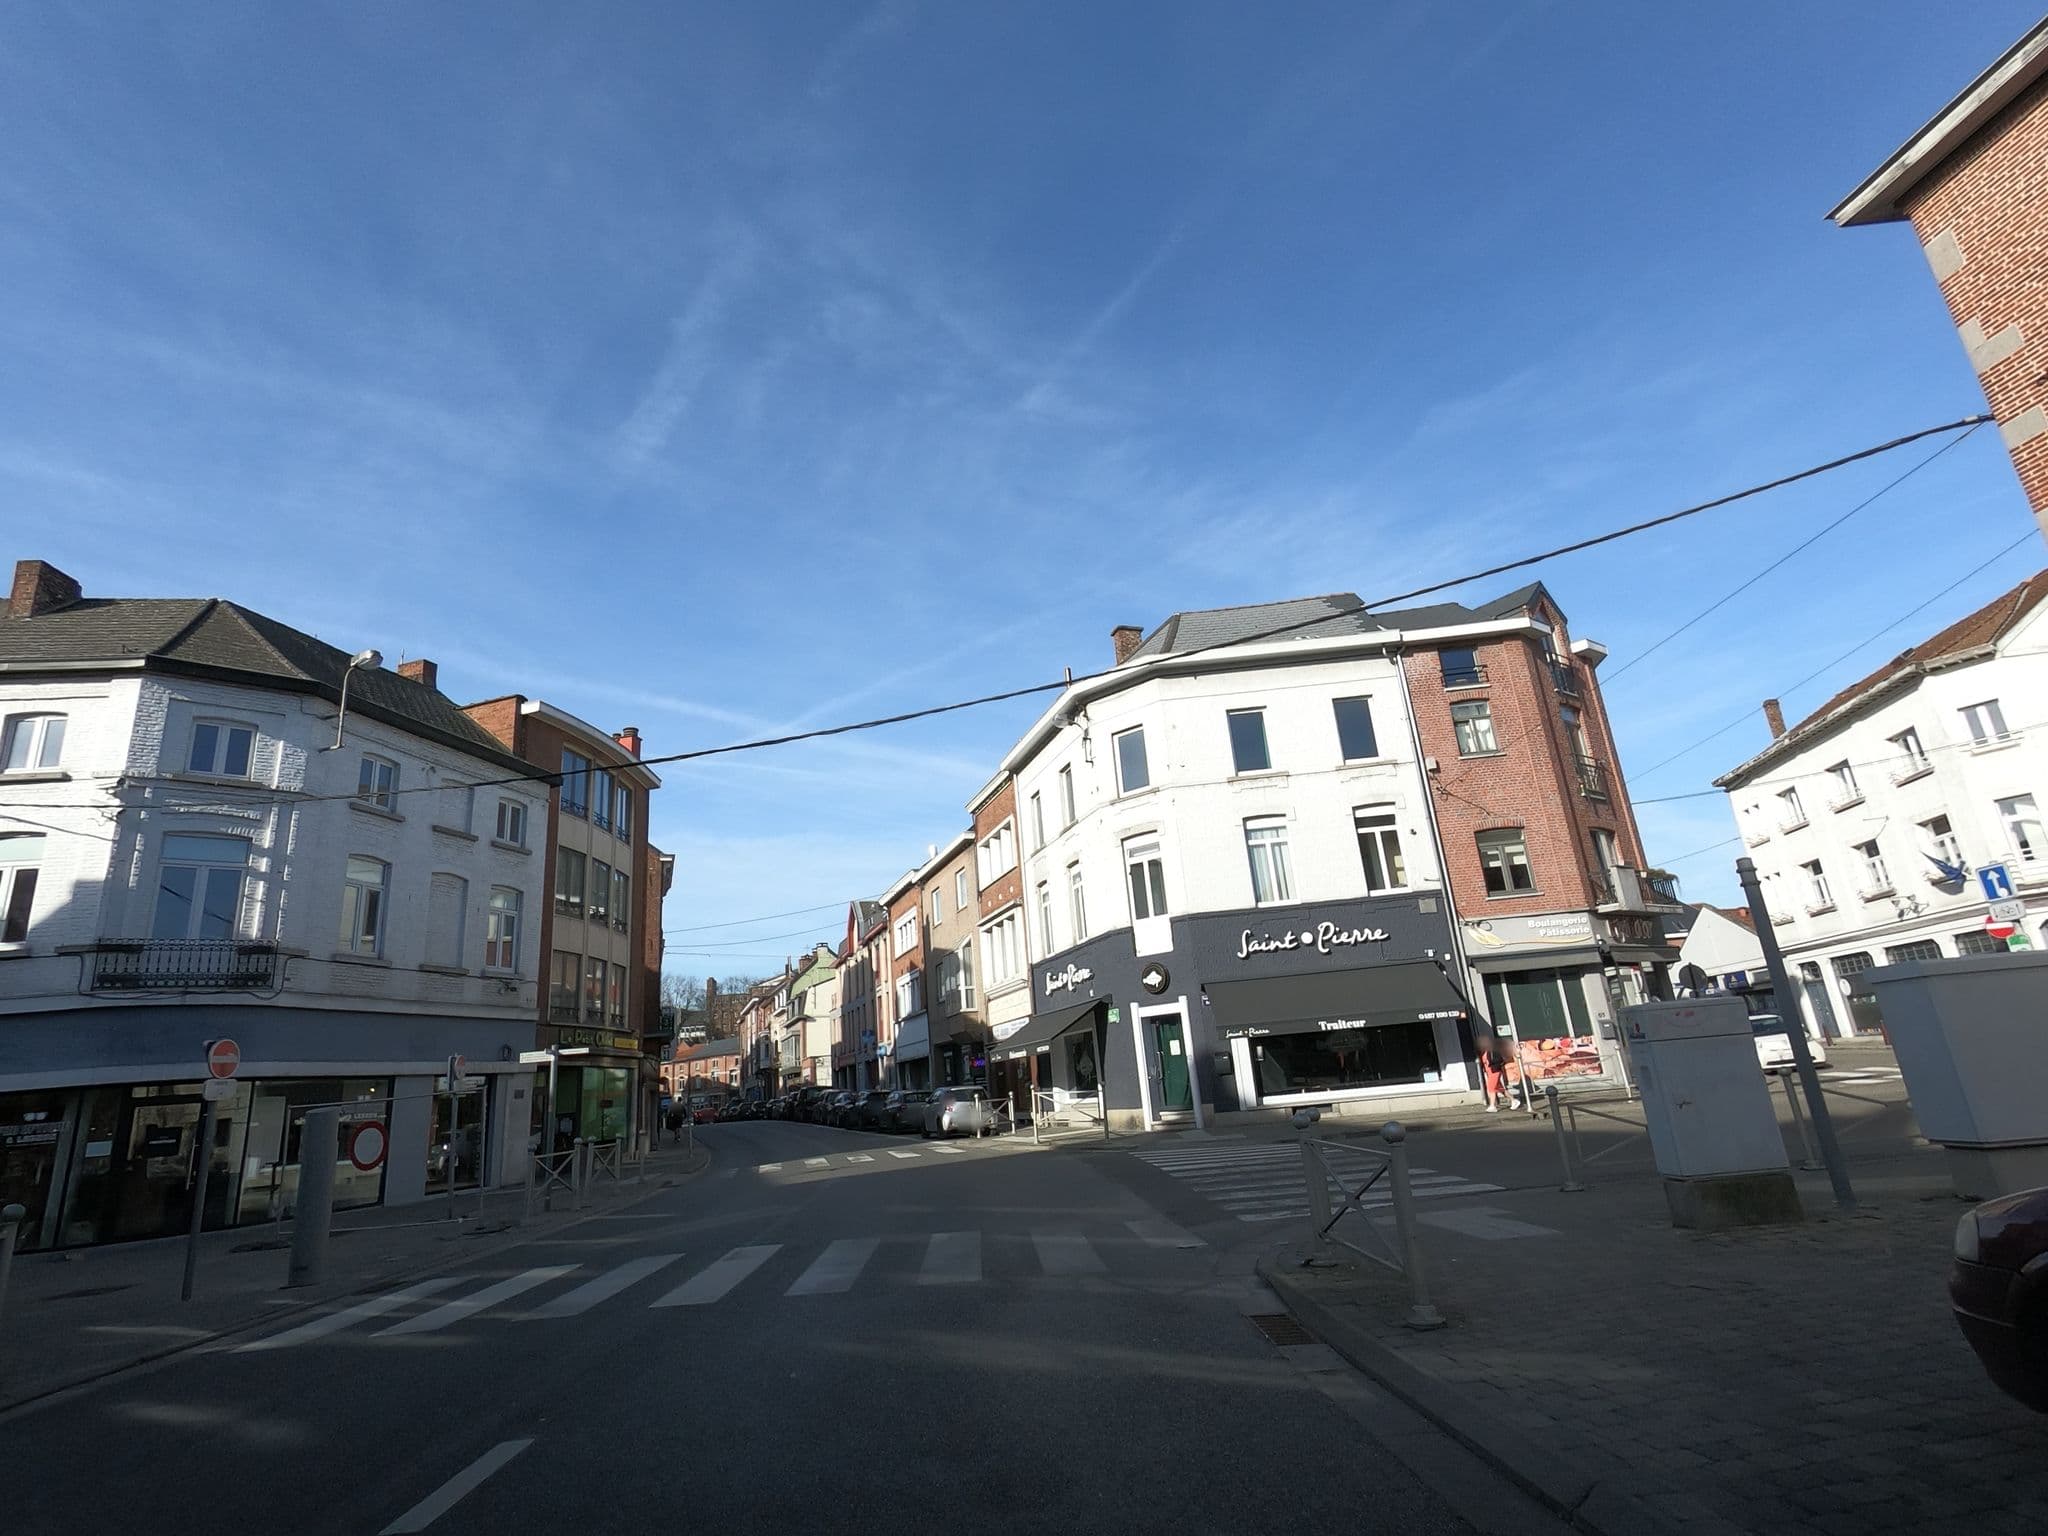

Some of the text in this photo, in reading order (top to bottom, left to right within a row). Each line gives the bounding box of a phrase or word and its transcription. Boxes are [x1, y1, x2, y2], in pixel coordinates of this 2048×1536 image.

[1527, 916, 1587, 928] Boulangerie
[1237, 921, 1389, 958] Saint Pierre
[1318, 1019, 1366, 1031] Traiteur
